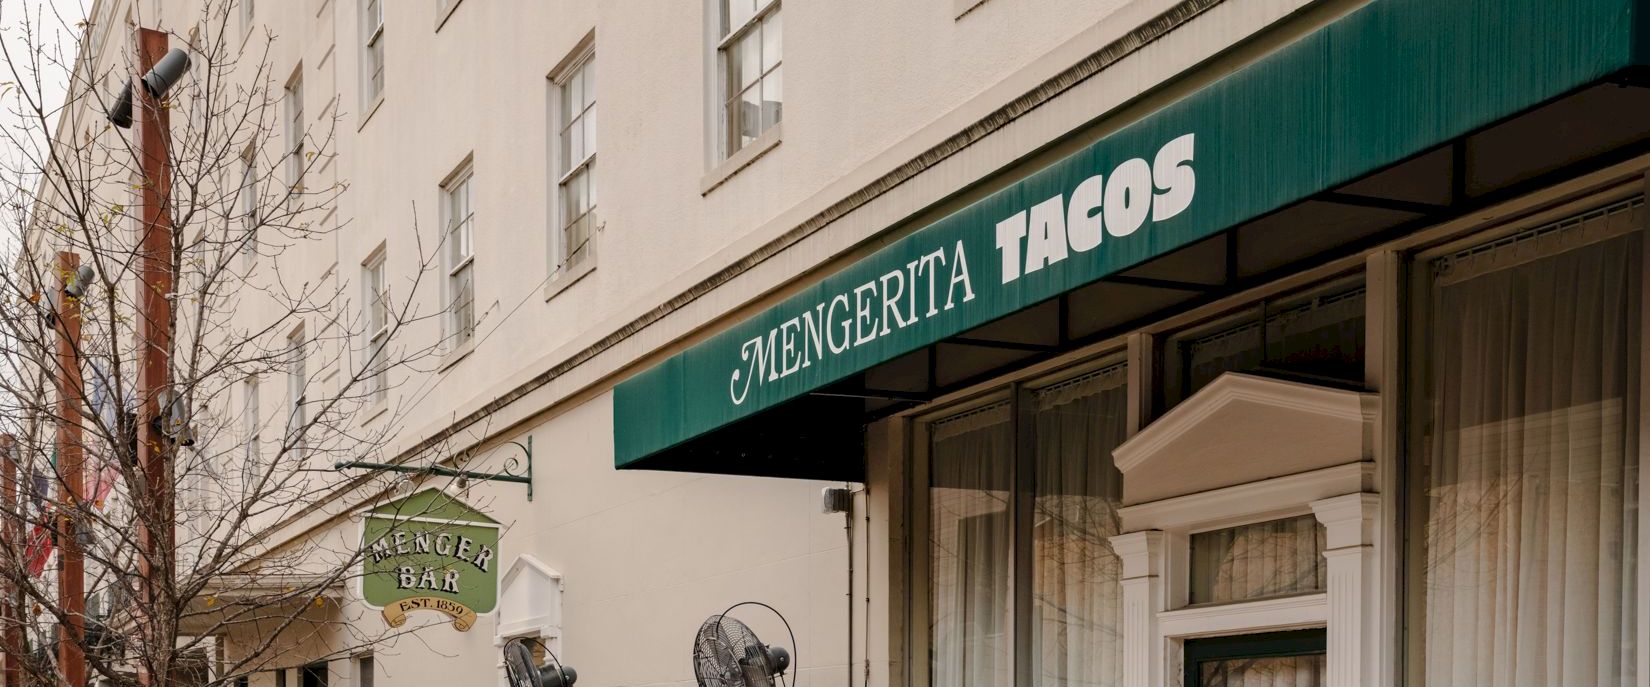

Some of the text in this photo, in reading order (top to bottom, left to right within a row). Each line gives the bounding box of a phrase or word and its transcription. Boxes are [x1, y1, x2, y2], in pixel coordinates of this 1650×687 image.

[730, 133, 1196, 405] MENGERITA TACOS
[368, 531, 494, 573] MENGER
[397, 566, 460, 594] BAR
[400, 598, 464, 615] EST. 1859
